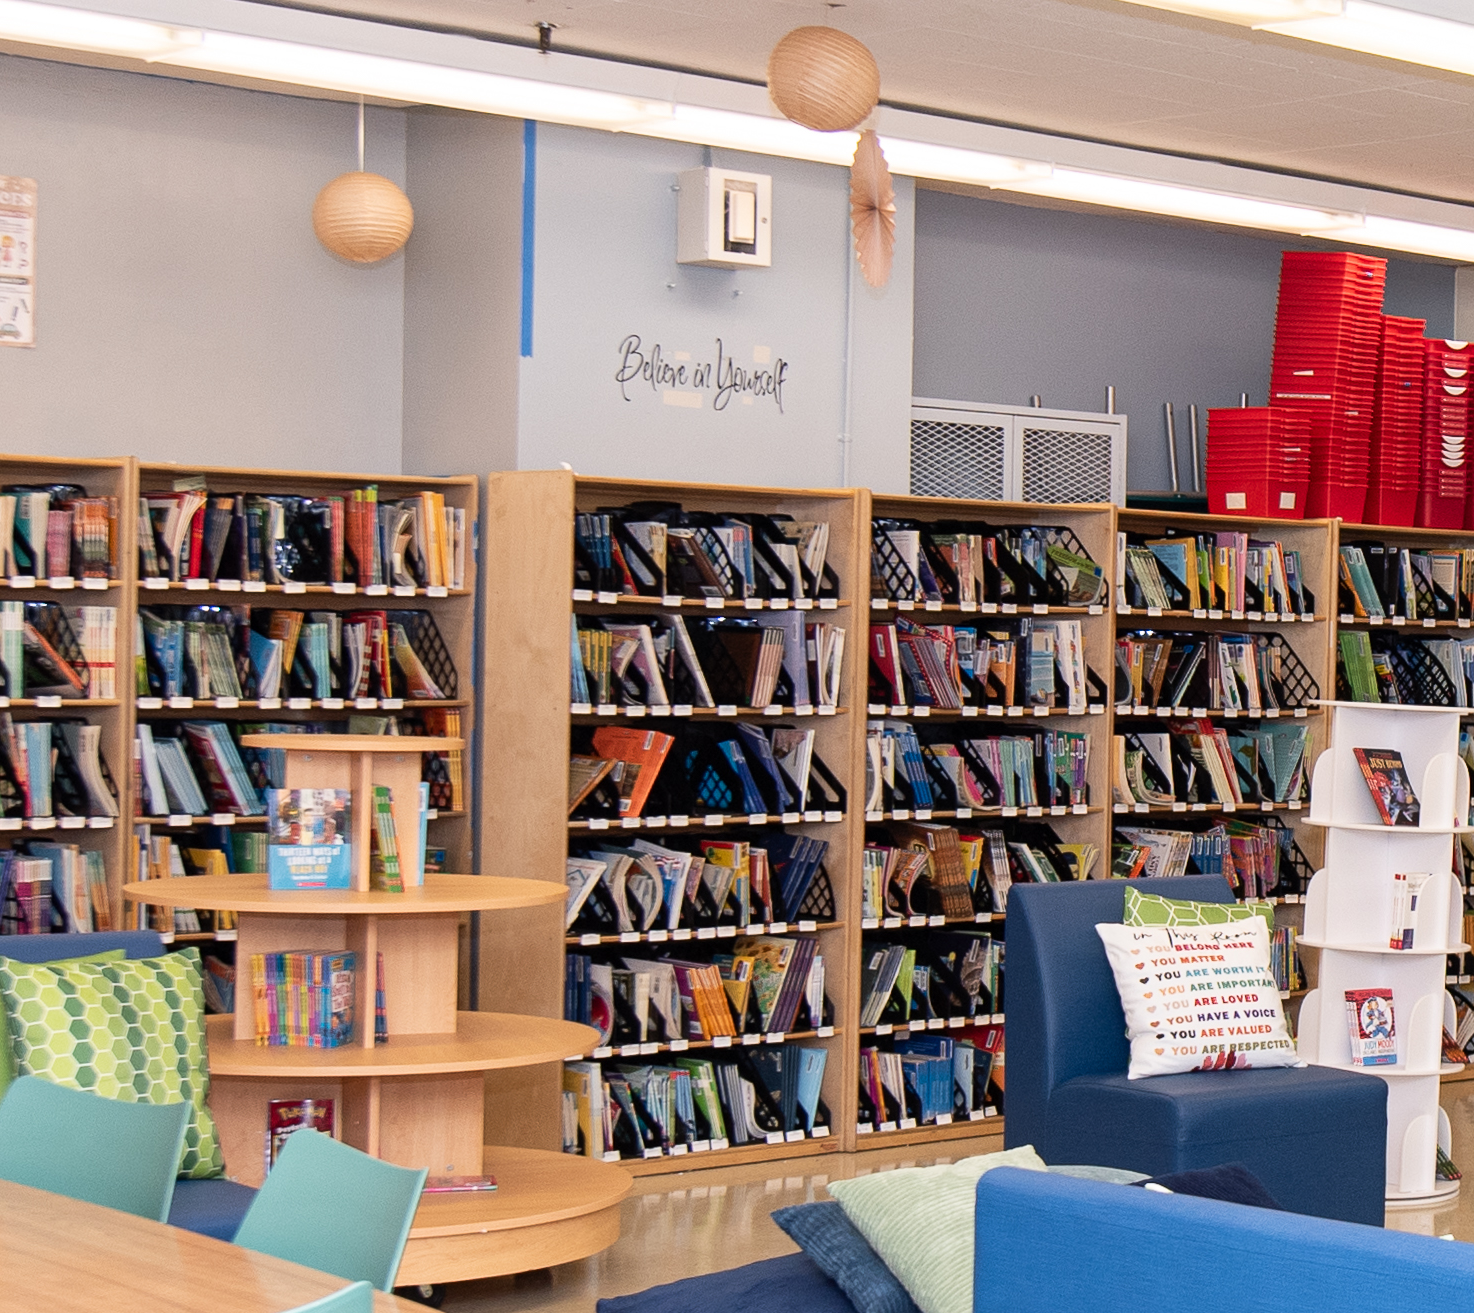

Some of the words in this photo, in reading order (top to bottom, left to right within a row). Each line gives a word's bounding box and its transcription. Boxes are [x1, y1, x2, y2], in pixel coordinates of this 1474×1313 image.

[615, 334, 689, 402] Believe
[693, 362, 712, 388] in
[713, 338, 789, 414] Yourself
[1369, 757, 1385, 768] JUST
[1146, 946, 1170, 954] YOU
[1175, 942, 1221, 952] BELONG
[1225, 941, 1255, 950] HERE
[1151, 957, 1177, 967] YOU
[1180, 954, 1226, 964] MATTER
[1155, 971, 1181, 981] YOU
[1185, 968, 1209, 978] ARE
[1212, 966, 1253, 976] WORTH
[1159, 985, 1185, 996] YOU
[1190, 982, 1214, 992] ARE
[1163, 1000, 1189, 1011] YOU
[1194, 997, 1218, 1007] ARE
[1221, 994, 1259, 1004] LOVED
[1166, 1015, 1193, 1026] YOU
[1197, 1011, 1229, 1022] HAVE
[1233, 1010, 1241, 1019] A
[1244, 1009, 1276, 1018] VOICE
[1170, 1030, 1196, 1039] YOU
[1200, 1027, 1224, 1038] ARE
[1227, 1024, 1272, 1036] VALUED
[1171, 1046, 1197, 1056] YOU
[1201, 1043, 1225, 1054] ARE
[1229, 1039, 1290, 1053] RESPECTED
